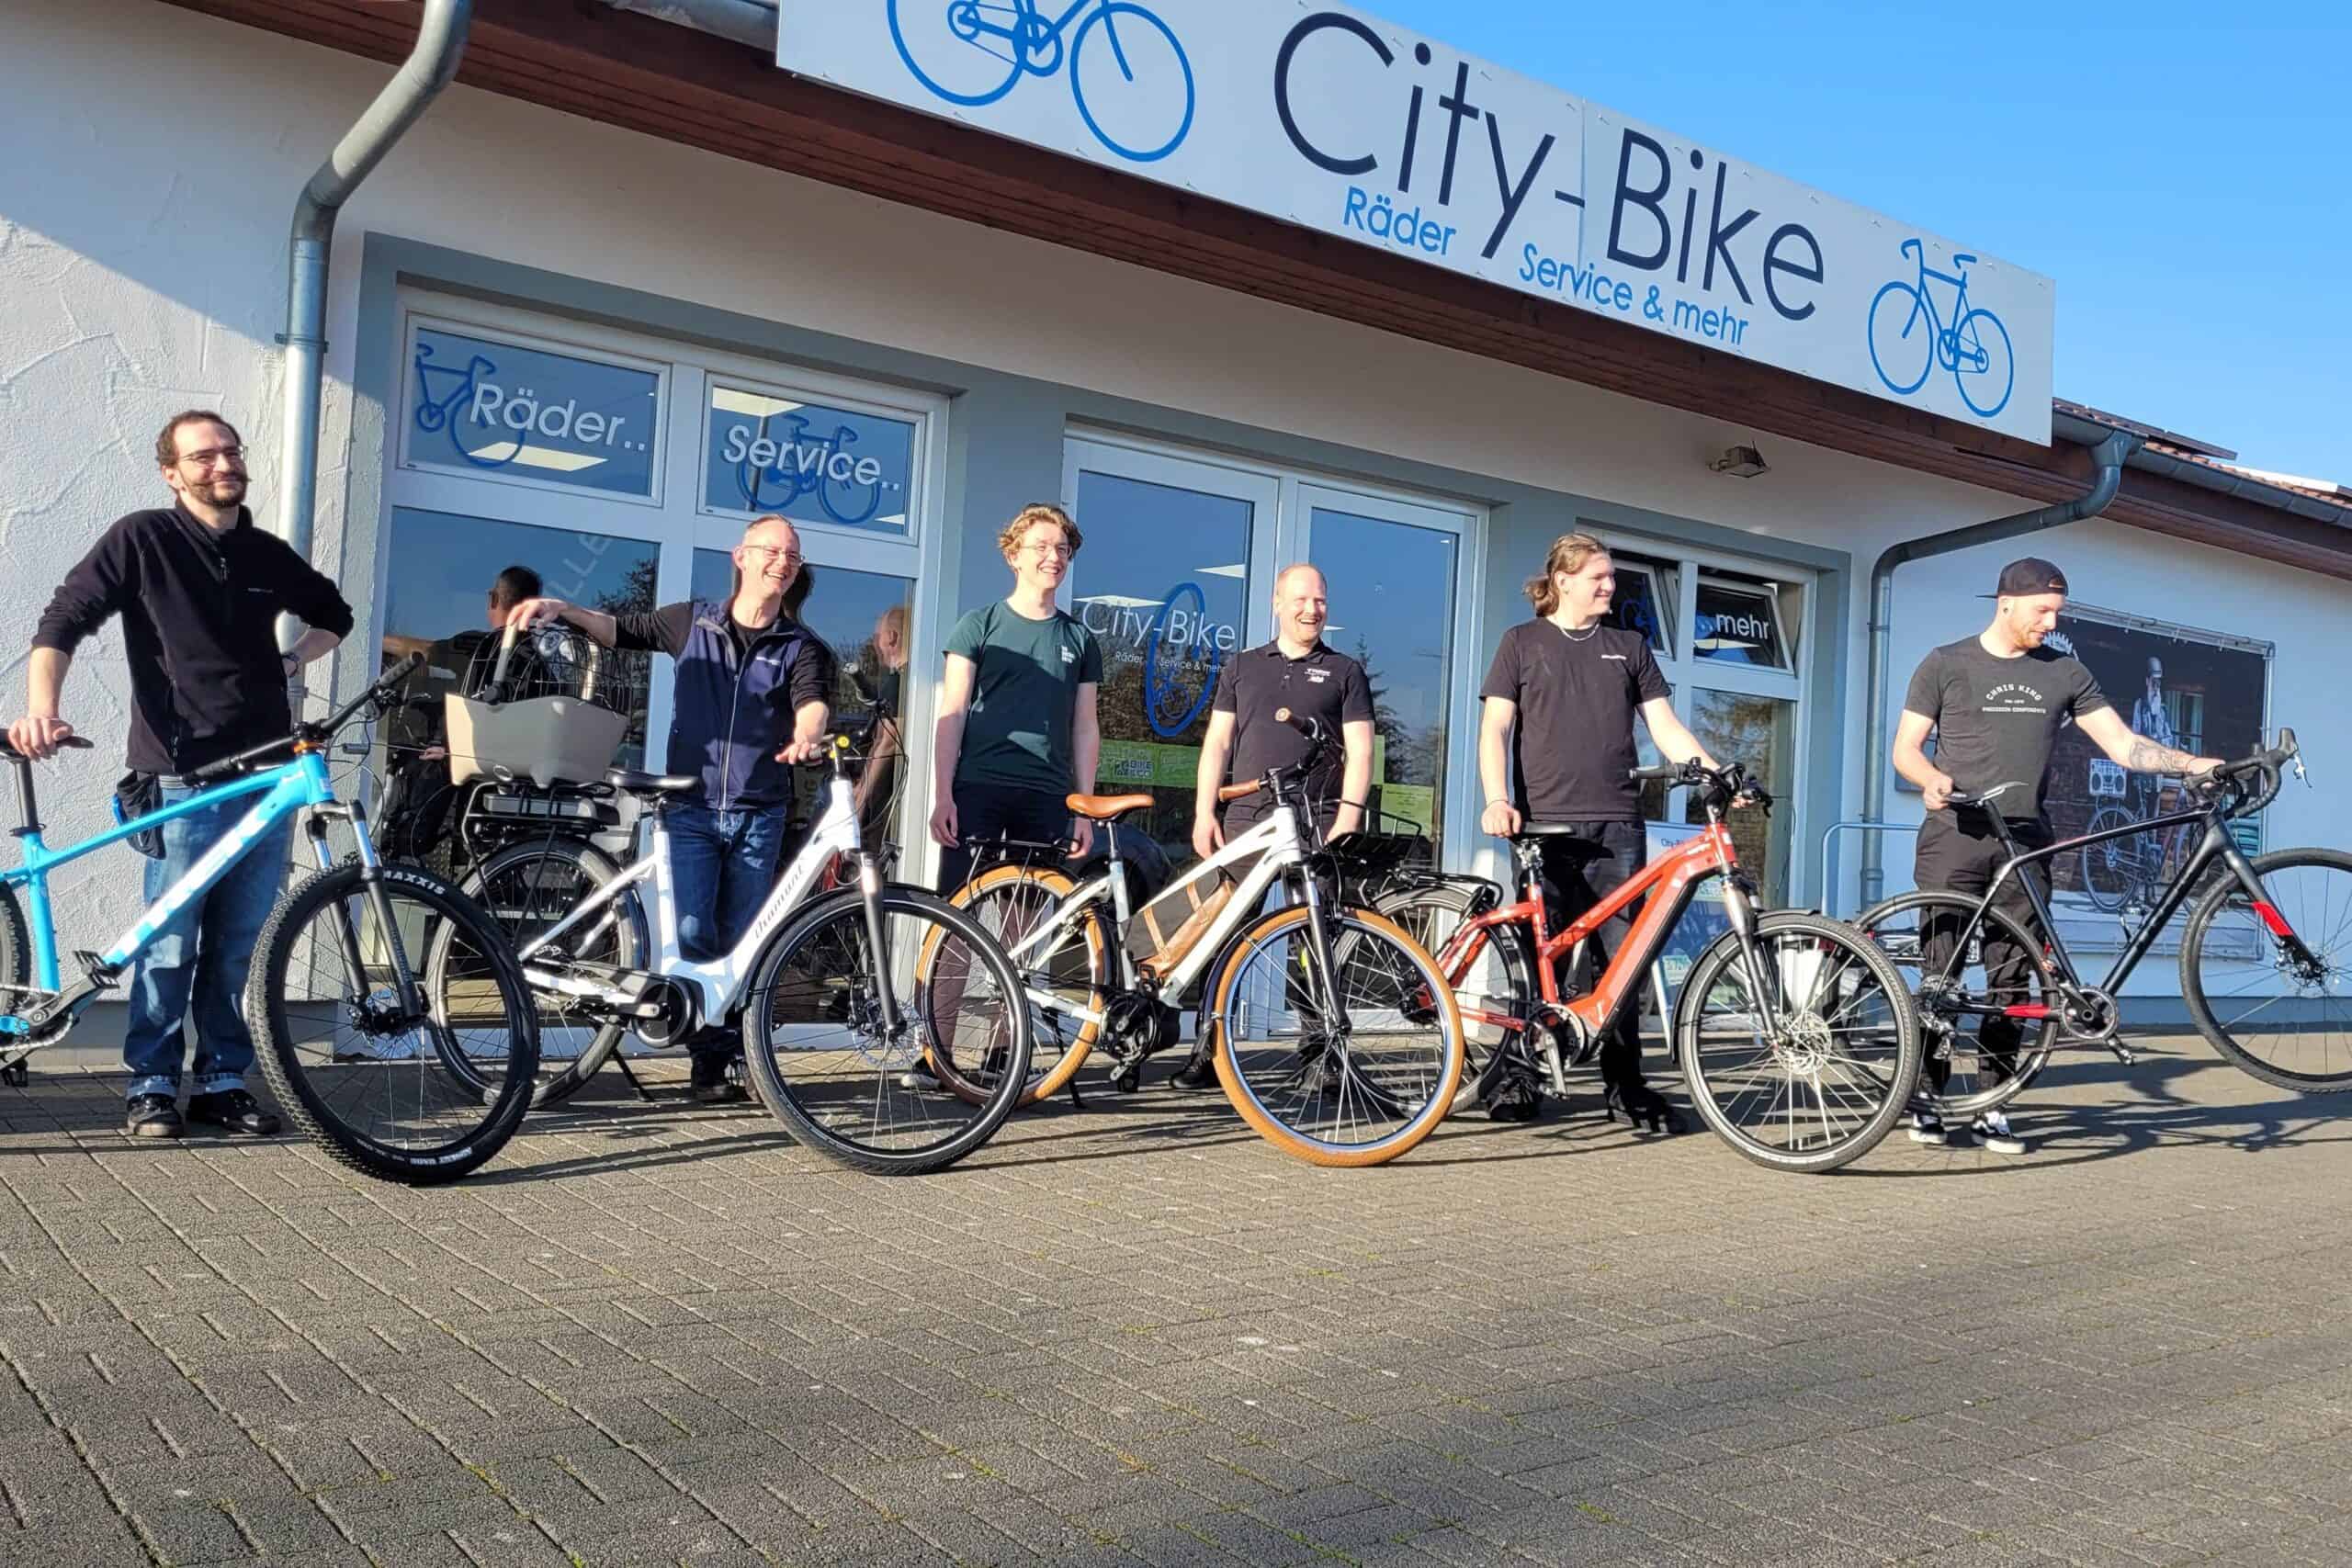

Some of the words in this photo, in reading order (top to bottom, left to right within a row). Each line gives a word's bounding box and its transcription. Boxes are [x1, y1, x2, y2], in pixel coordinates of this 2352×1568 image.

[1273, 12, 1825, 321] City-Bike
[1342, 184, 1457, 256] Räder
[1519, 243, 1633, 311] Service
[1643, 284, 1665, 323] &
[1673, 295, 1749, 346] mehr
[1082, 599, 1236, 650] City-Bike
